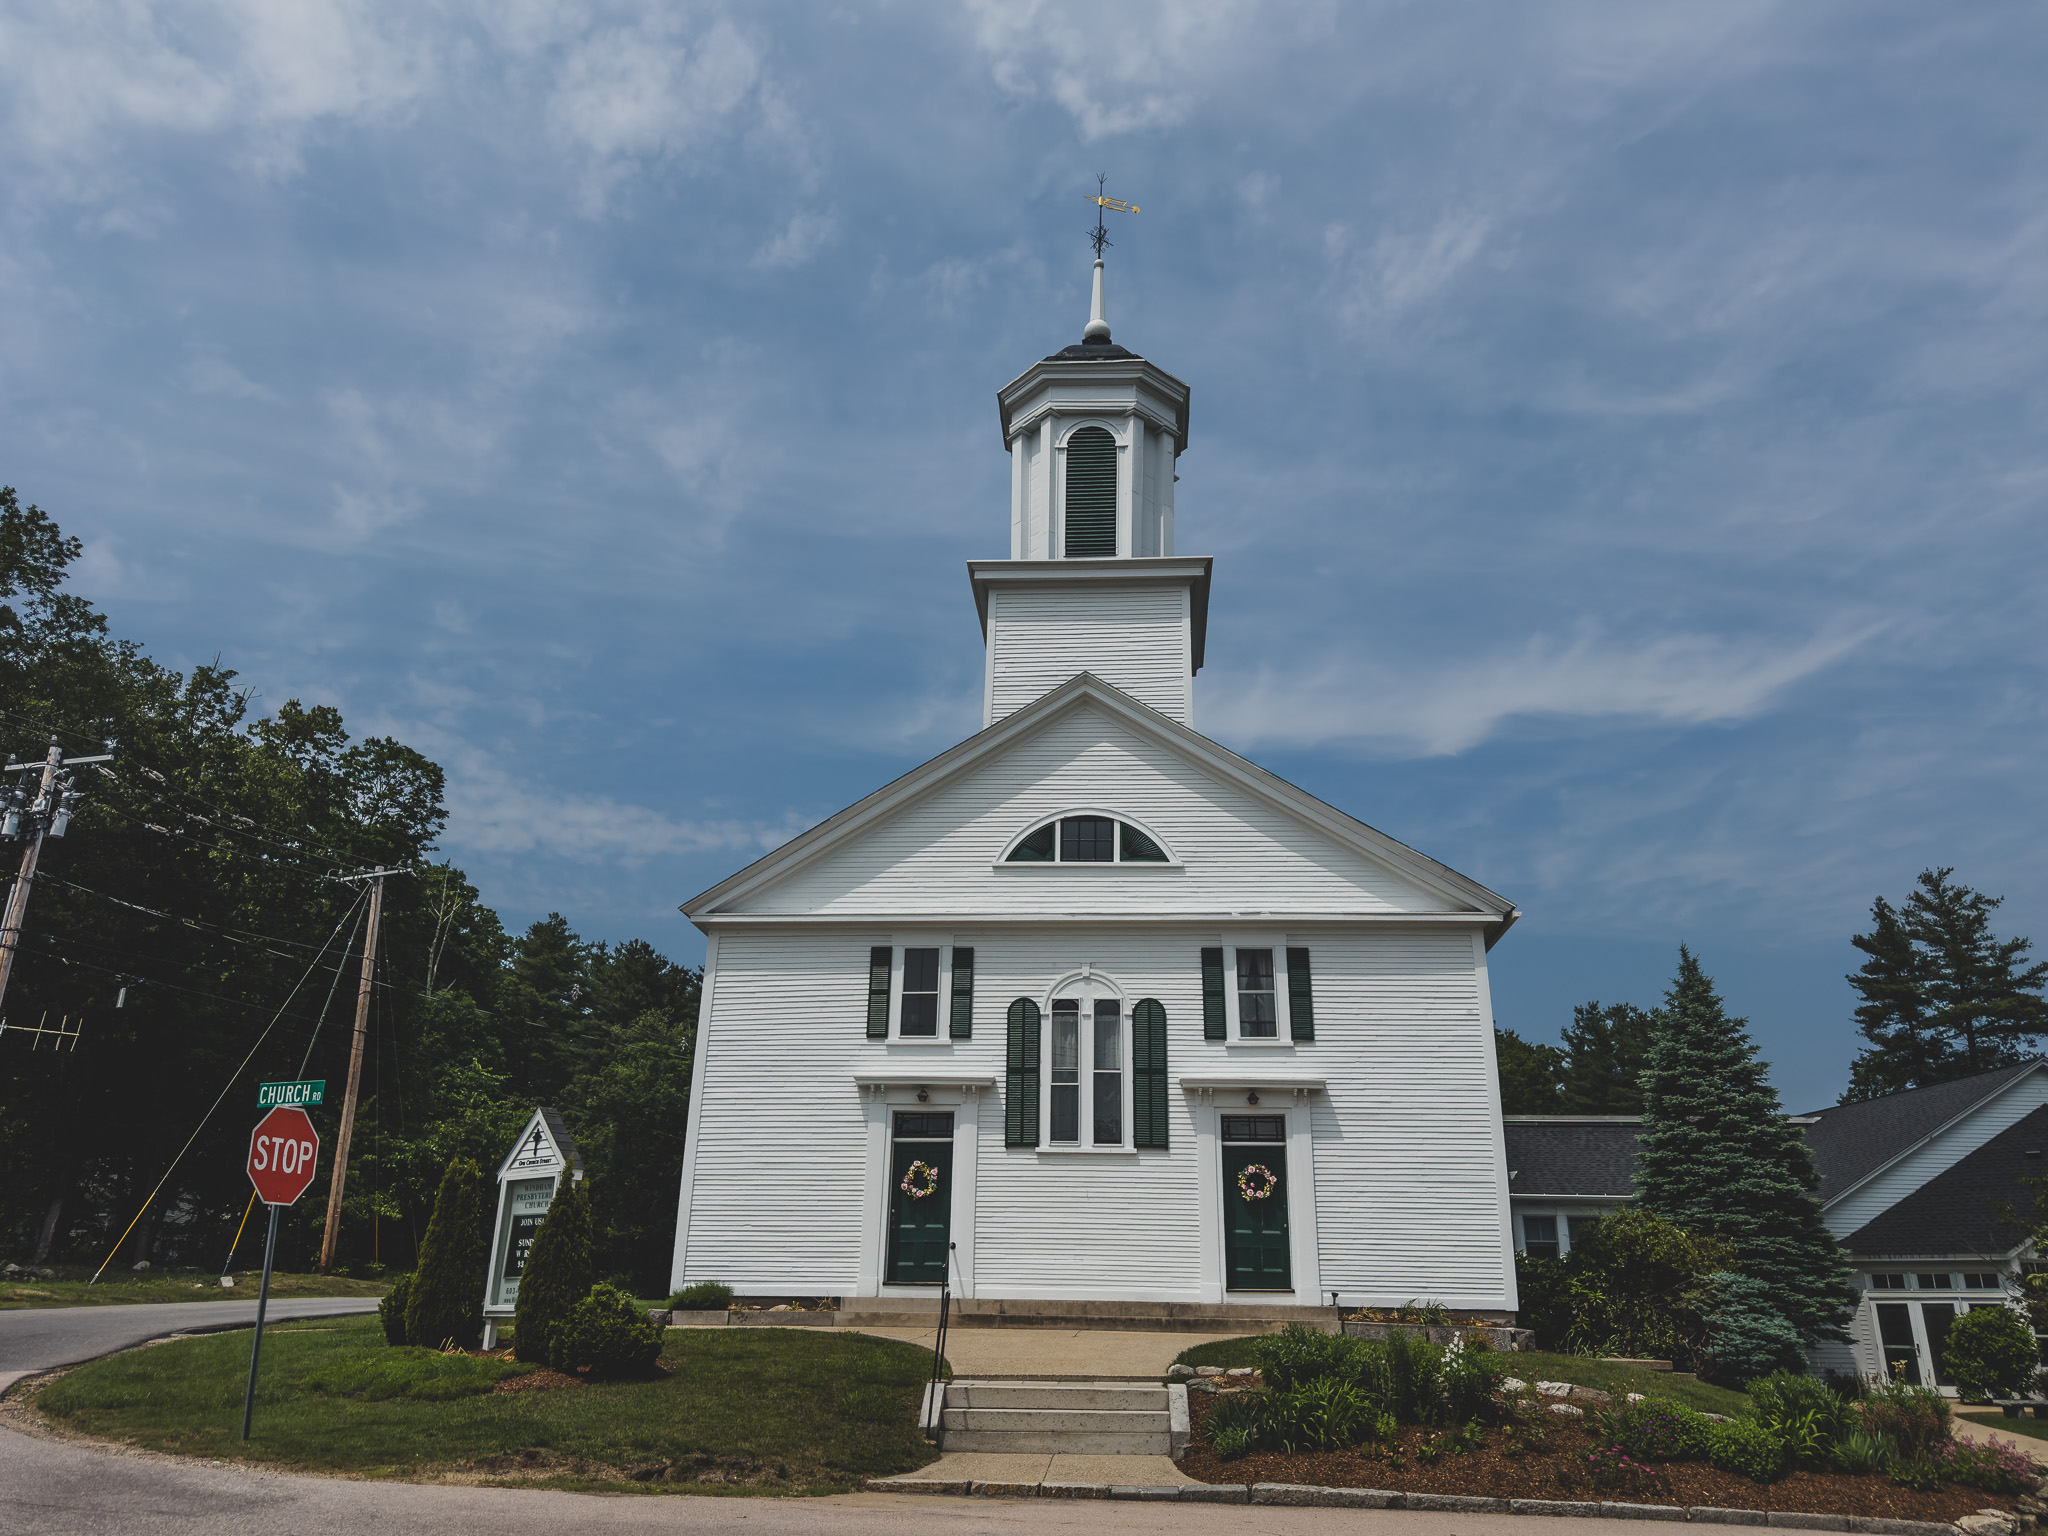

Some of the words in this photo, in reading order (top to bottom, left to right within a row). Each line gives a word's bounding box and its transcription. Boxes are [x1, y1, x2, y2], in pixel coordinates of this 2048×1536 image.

[260, 1085, 310, 1104] CHURCH
[312, 1092, 322, 1101] RD
[254, 1135, 313, 1174] STOP
[524, 1183, 552, 1192] WINDHAM
[516, 1192, 552, 1201] PRESBYTERI
[524, 1201, 549, 1209] CHURCH
[520, 1218, 533, 1227] JOIN
[505, 1287, 518, 1295] 603-
